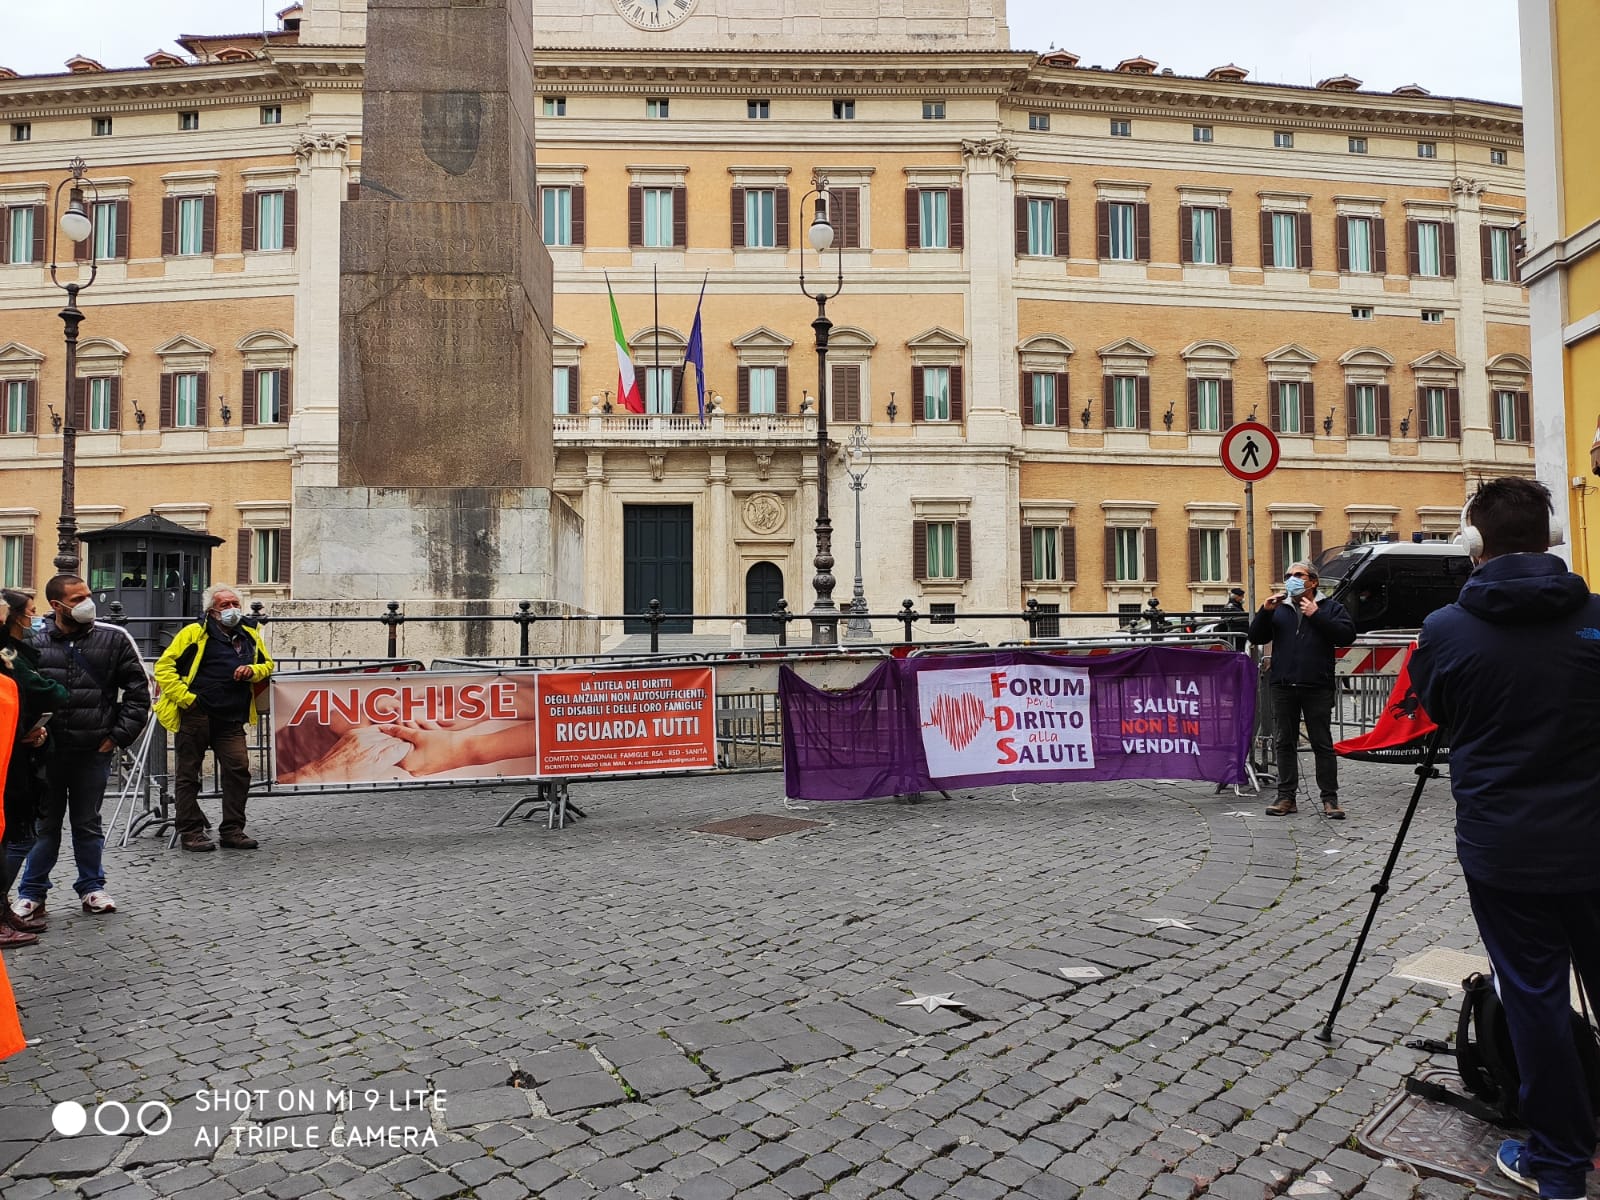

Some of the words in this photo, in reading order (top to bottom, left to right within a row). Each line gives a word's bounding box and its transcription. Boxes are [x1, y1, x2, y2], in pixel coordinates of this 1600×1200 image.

[581, 681, 591, 691] LA
[593, 680, 623, 691] TUTELA
[626, 680, 639, 690] DEI
[642, 678, 672, 689] DIRITTI
[990, 672, 1085, 698] FORUM
[1175, 679, 1200, 696] LA
[287, 682, 518, 727] ANCHISE
[545, 694, 570, 705] DEGLI
[573, 693, 608, 704] ANZIANI
[611, 692, 629, 702] NON
[1026, 697, 1043, 709] per
[1046, 697, 1054, 709] il
[1133, 698, 1199, 715] SALUTE
[550, 706, 564, 717] DEI
[567, 705, 603, 716] DISABILI
[606, 704, 610, 714] E
[613, 703, 637, 714] DELLE
[639, 702, 661, 713] LORO
[664, 701, 703, 712] FAMIGLIE
[994, 706, 1084, 732] DIRITTO
[1121, 718, 1162, 735] NON
[1167, 713, 1178, 734] È
[1182, 719, 1199, 736] IN
[556, 719, 648, 742] RIGUARDA
[652, 716, 699, 737] TUTTI
[1028, 730, 1058, 743] alla
[996, 737, 1088, 765] SALUTE
[1122, 738, 1200, 756] VENDITA
[544, 755, 579, 763] COMITATO
[581, 753, 617, 761] NAZIONALE
[620, 751, 649, 759] FAMIGLIE
